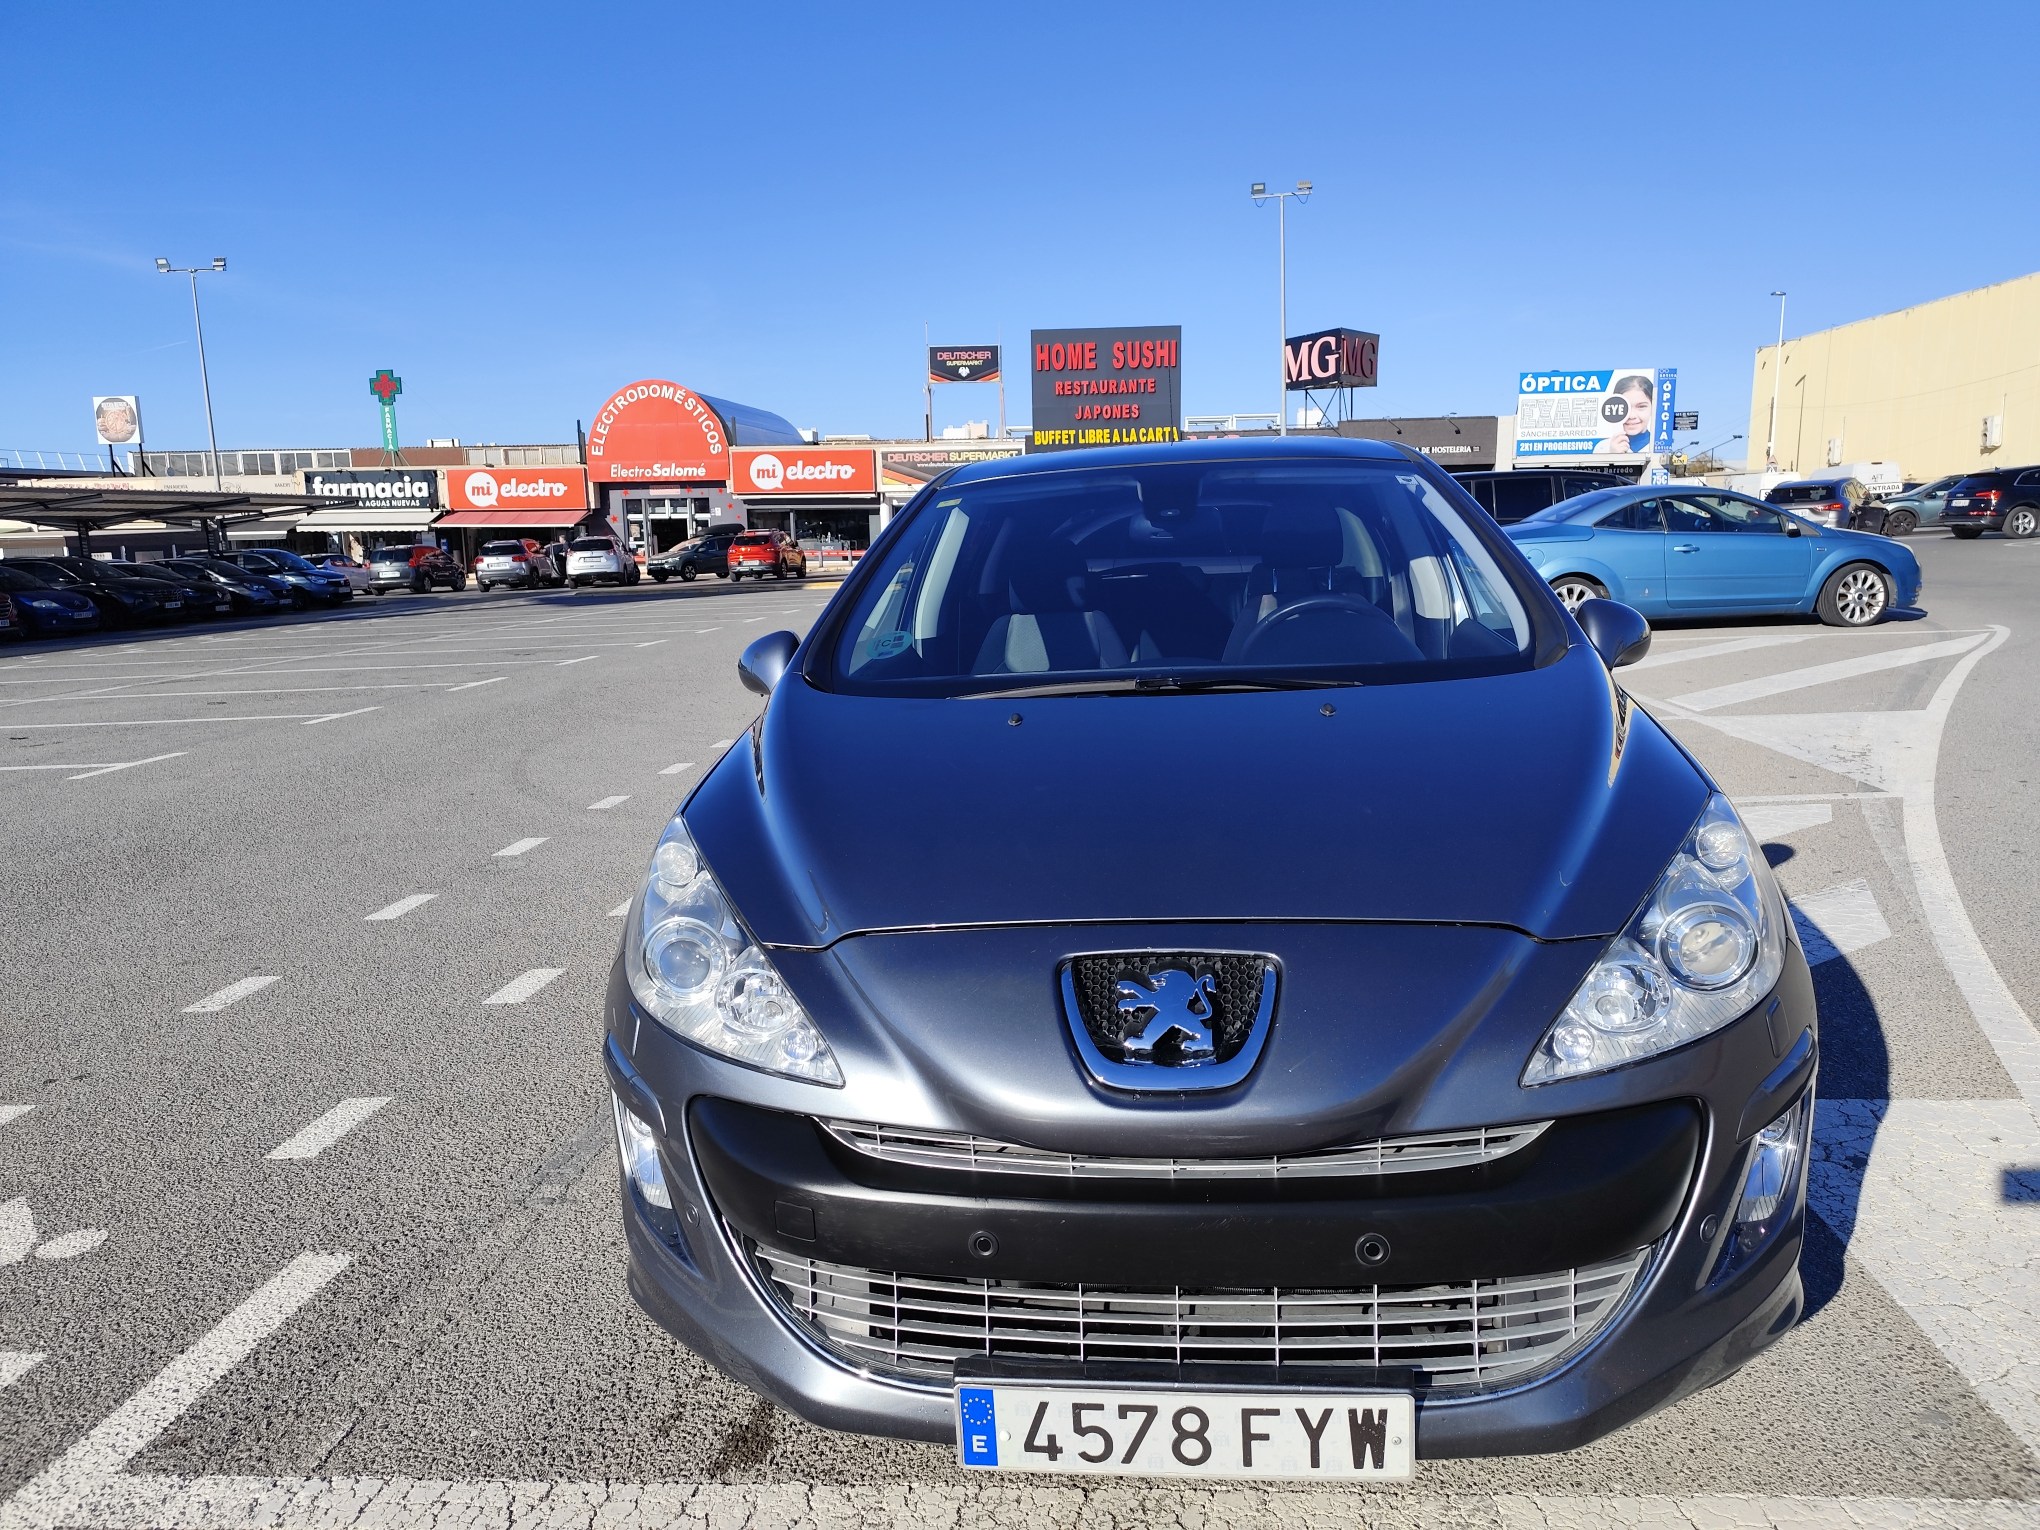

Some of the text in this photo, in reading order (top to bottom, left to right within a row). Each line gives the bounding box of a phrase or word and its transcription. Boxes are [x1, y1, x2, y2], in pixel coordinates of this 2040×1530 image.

[936, 350, 992, 361] DEUTSCHER
[1036, 339, 1177, 371] HOME SUSHI
[1286, 336, 1340, 383] MG
[1341, 334, 1377, 379] MG
[1055, 378, 1156, 396] RESTAURANTE
[1521, 374, 1601, 392] ÓPTICA
[1074, 404, 1140, 420] JAPONES
[1520, 398, 1598, 429] EXAM
[1604, 404, 1625, 416] EYE
[384, 406, 395, 450] FARMACIA
[591, 384, 722, 457] ELECTRODOMÉSTICOS
[1034, 429, 1076, 445] BUFFET
[1078, 428, 1110, 444] LIBRE
[1112, 428, 1120, 443] A
[1123, 427, 1138, 443] LA
[1520, 429, 1598, 438] SÁNCHEZ BARREDO
[1421, 446, 1430, 454] DE
[1520, 440, 1594, 452] 2X1 EN PROGRESIVOS
[887, 450, 1019, 463] DEUTSCHER SUPERMARKT
[610, 463, 706, 478] ElectroSalomé
[756, 460, 855, 480] mi electro
[313, 475, 429, 498] farmacia
[471, 478, 567, 498] mi electro
[1868, 484, 1901, 492] ENTRADA
[365, 499, 391, 507] AGUAS
[392, 499, 420, 507] NUEVAS
[1023, 1400, 1213, 1466] 4578
[972, 1435, 988, 1454] E
